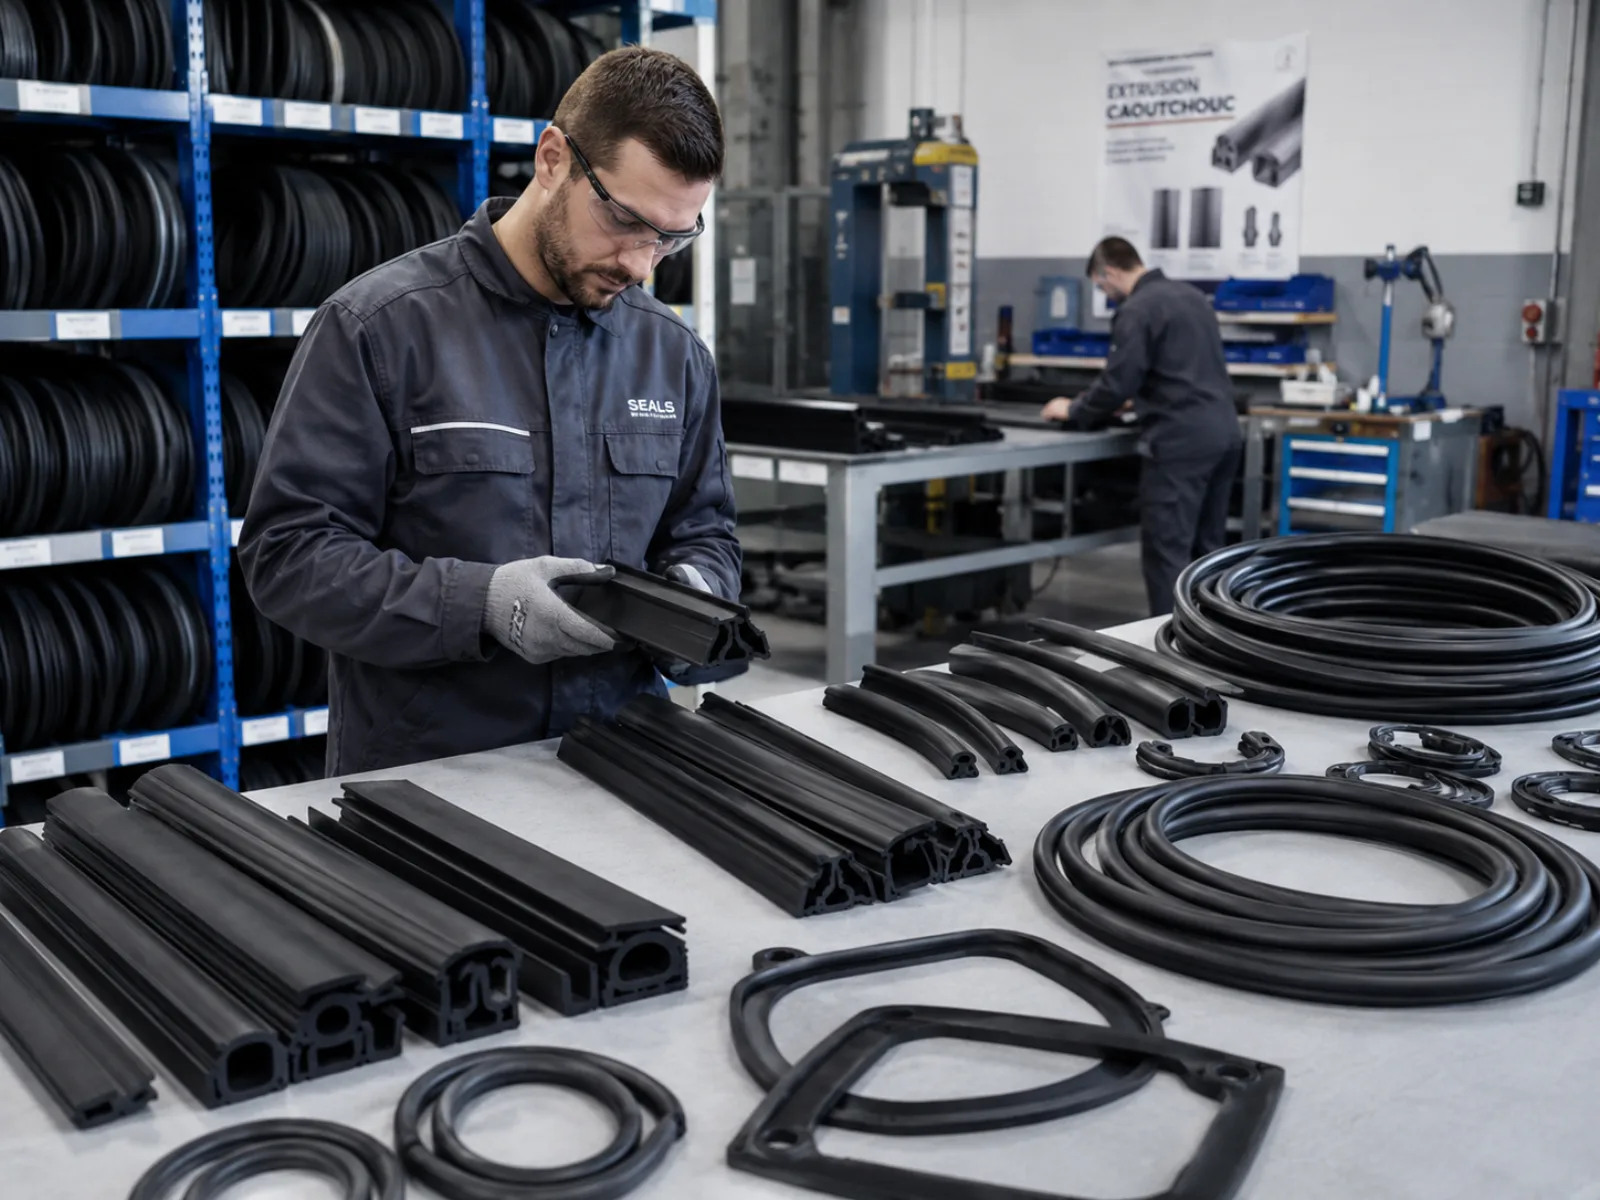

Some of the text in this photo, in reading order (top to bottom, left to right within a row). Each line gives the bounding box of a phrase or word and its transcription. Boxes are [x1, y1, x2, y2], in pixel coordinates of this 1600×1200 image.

[1107, 78, 1199, 99] EXTRUSION
[1106, 96, 1235, 119] CAOUTCHOUC
[627, 399, 675, 413] SEALS
